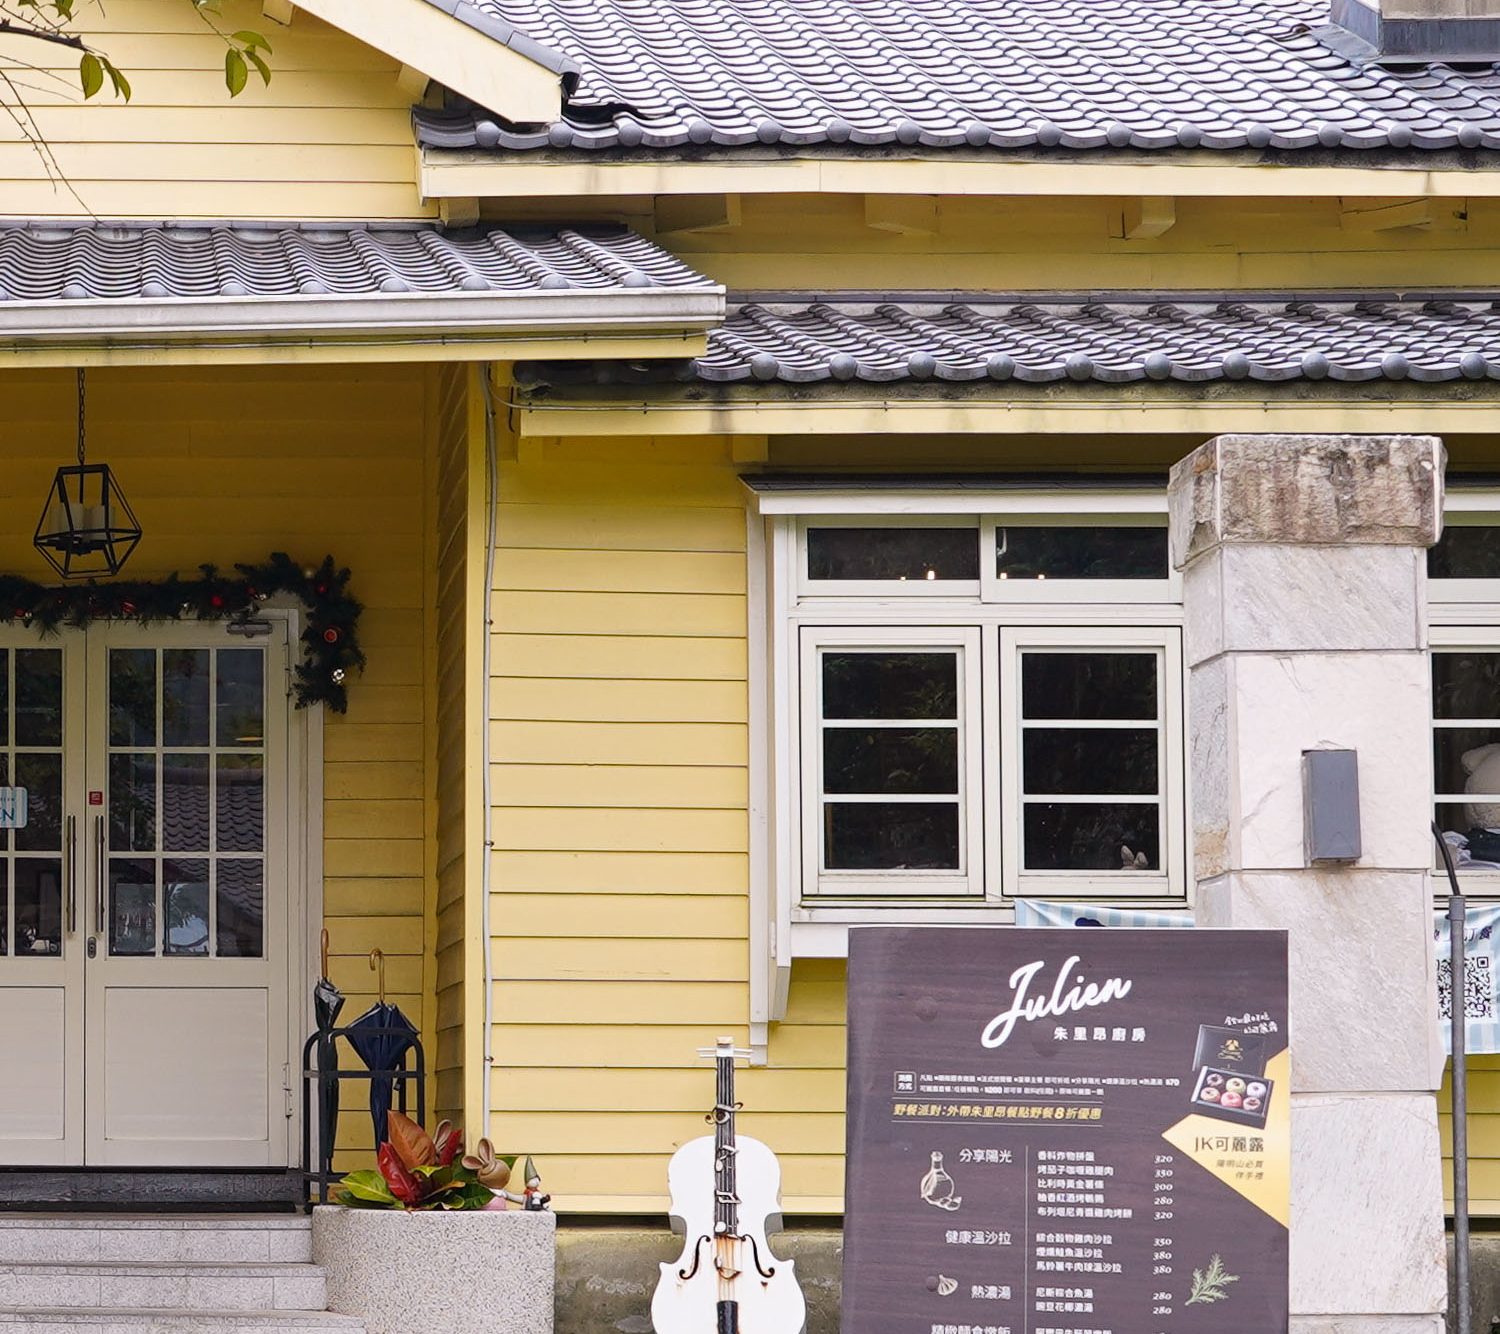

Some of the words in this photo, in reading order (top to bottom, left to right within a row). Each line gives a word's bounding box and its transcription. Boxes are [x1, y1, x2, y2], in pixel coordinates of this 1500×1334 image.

[981, 956, 1132, 1048] Julien
[1054, 1027, 1145, 1041] 朱里昂廚房
[1194, 1137, 1264, 1153] JK可麗露
[960, 1149, 1012, 1163] 分享陽光
[1216, 1159, 1264, 1168] 陽明山必買
[946, 1231, 1011, 1244] 健康溫沙拉
[972, 1286, 1010, 1299] 熱濃湯
